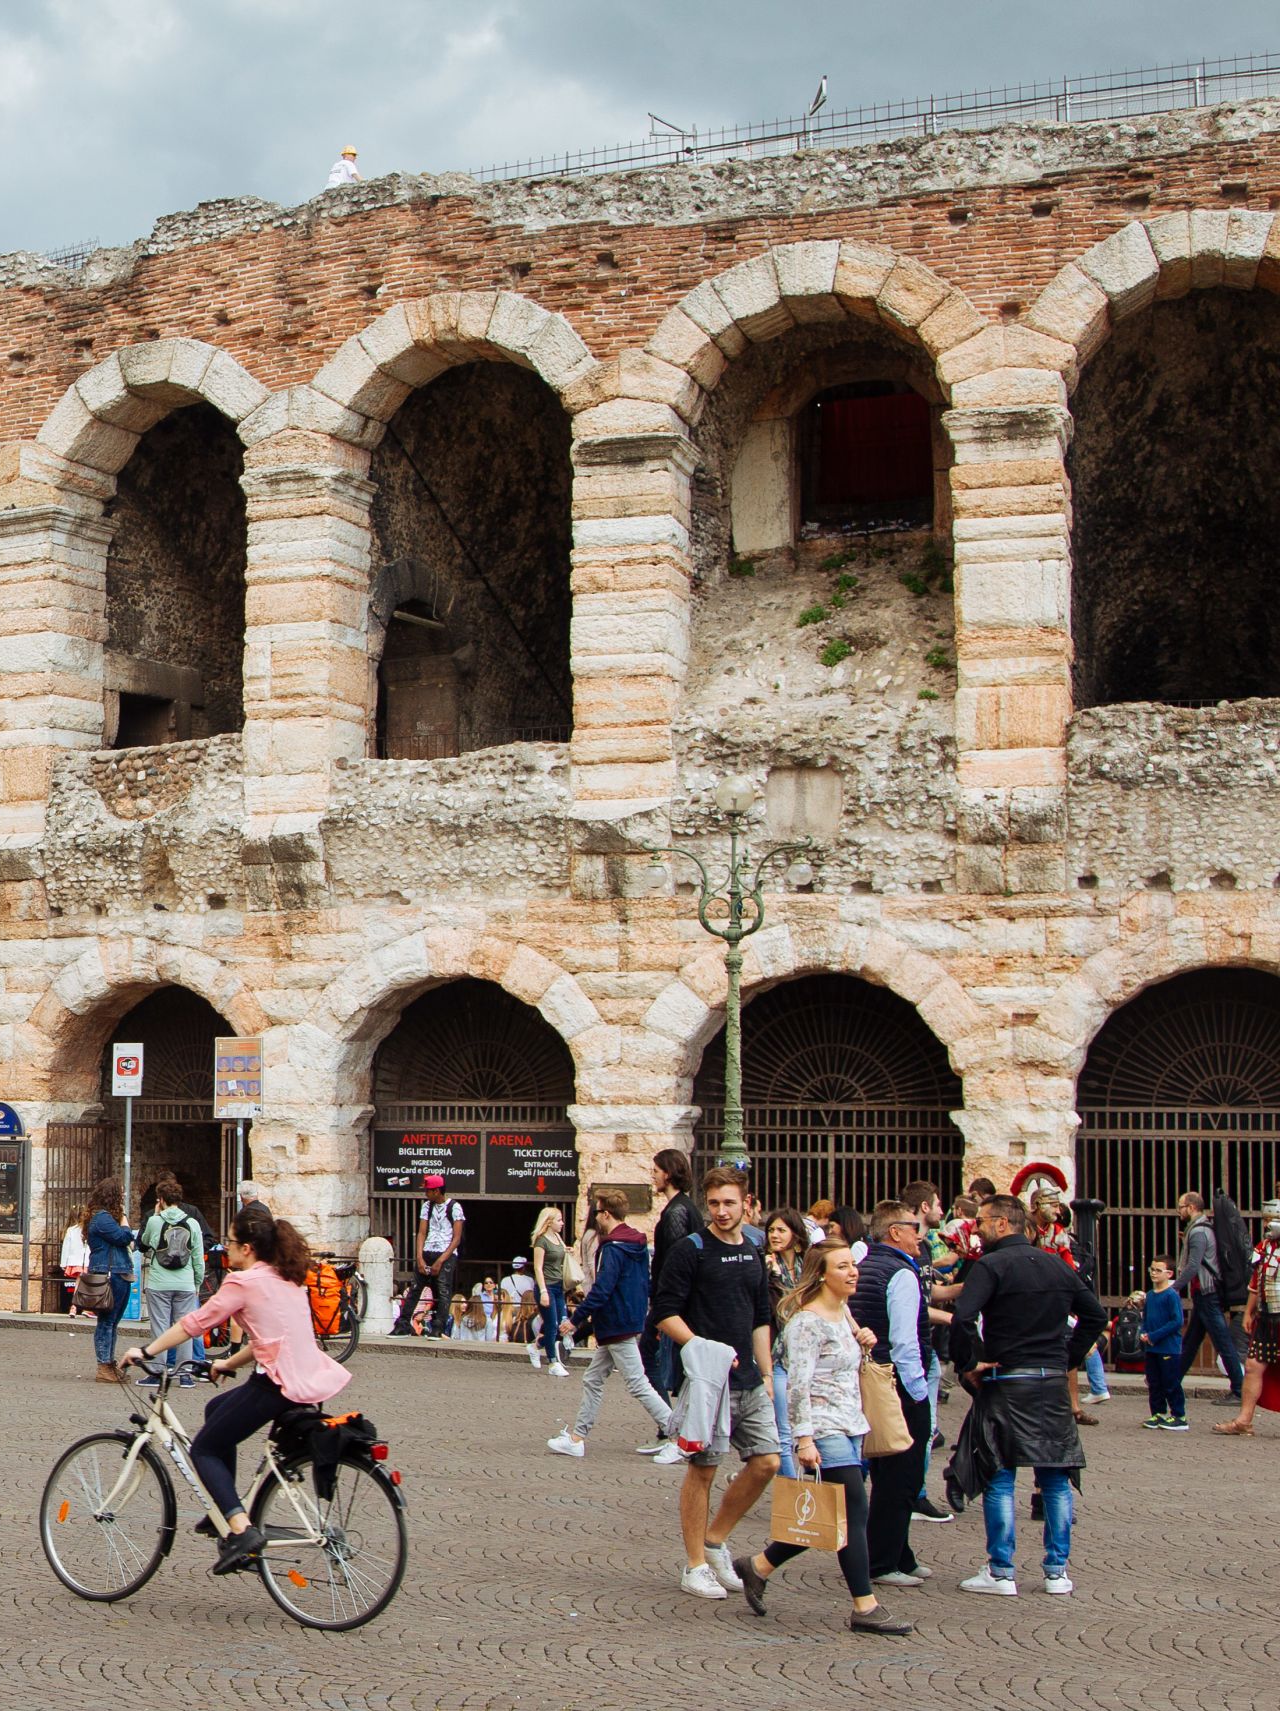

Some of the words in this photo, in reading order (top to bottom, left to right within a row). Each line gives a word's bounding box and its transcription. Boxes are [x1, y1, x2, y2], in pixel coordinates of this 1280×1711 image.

[402, 1134, 478, 1146] ANFITEATRO
[489, 1135, 533, 1146] ARENA
[398, 1148, 452, 1156] BIGLIETTERIA
[513, 1149, 542, 1157] TICKET
[543, 1149, 573, 1158] OFFICE
[376, 1166, 400, 1174] Verona
[423, 1166, 446, 1176] Gruppi
[450, 1167, 475, 1176] Groups
[507, 1168, 532, 1178] Singoli
[537, 1169, 576, 1177] Individuals
